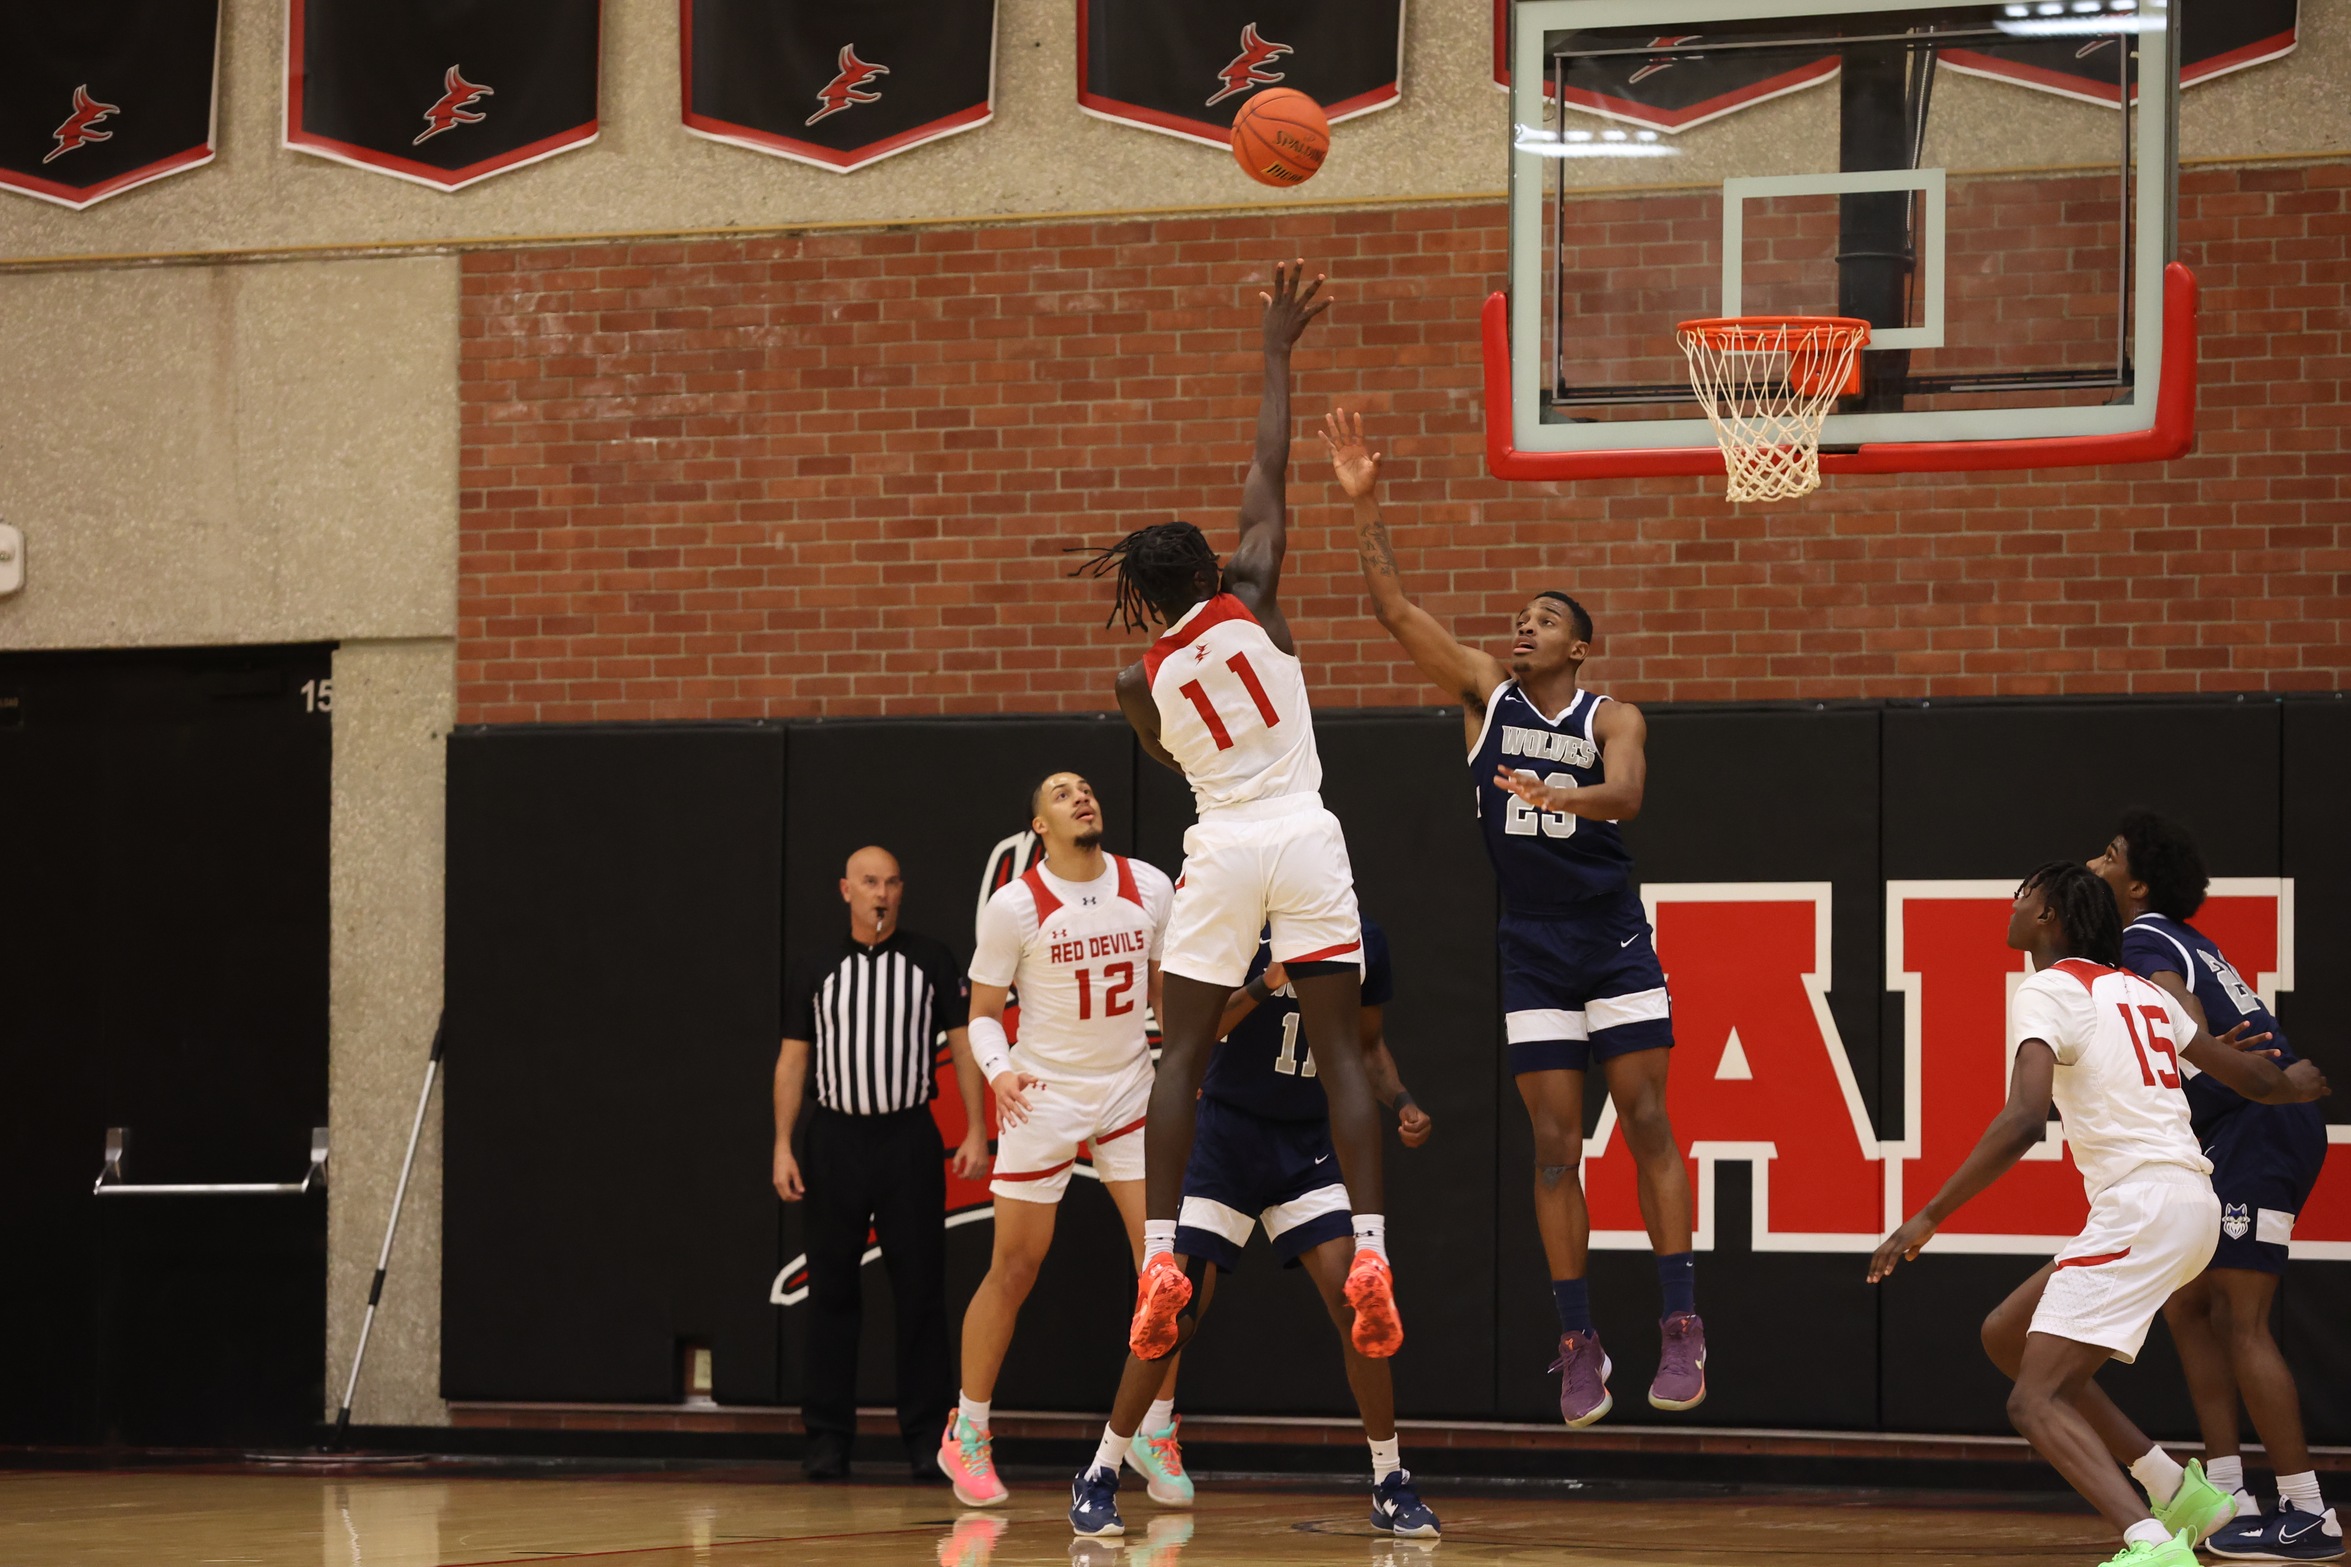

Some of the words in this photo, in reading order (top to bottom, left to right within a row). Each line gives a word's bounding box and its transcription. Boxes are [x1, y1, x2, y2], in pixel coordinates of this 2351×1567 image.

[300, 679, 332, 713] 15
[1179, 651, 1280, 751] 11
[1502, 725, 1597, 769] WOLVES
[1051, 940, 1084, 964] RED
[1089, 930, 1145, 958] DEVILS
[1075, 961, 1135, 1020] 12
[2196, 948, 2261, 1016] 2
[2116, 1002, 2181, 1089] 15
